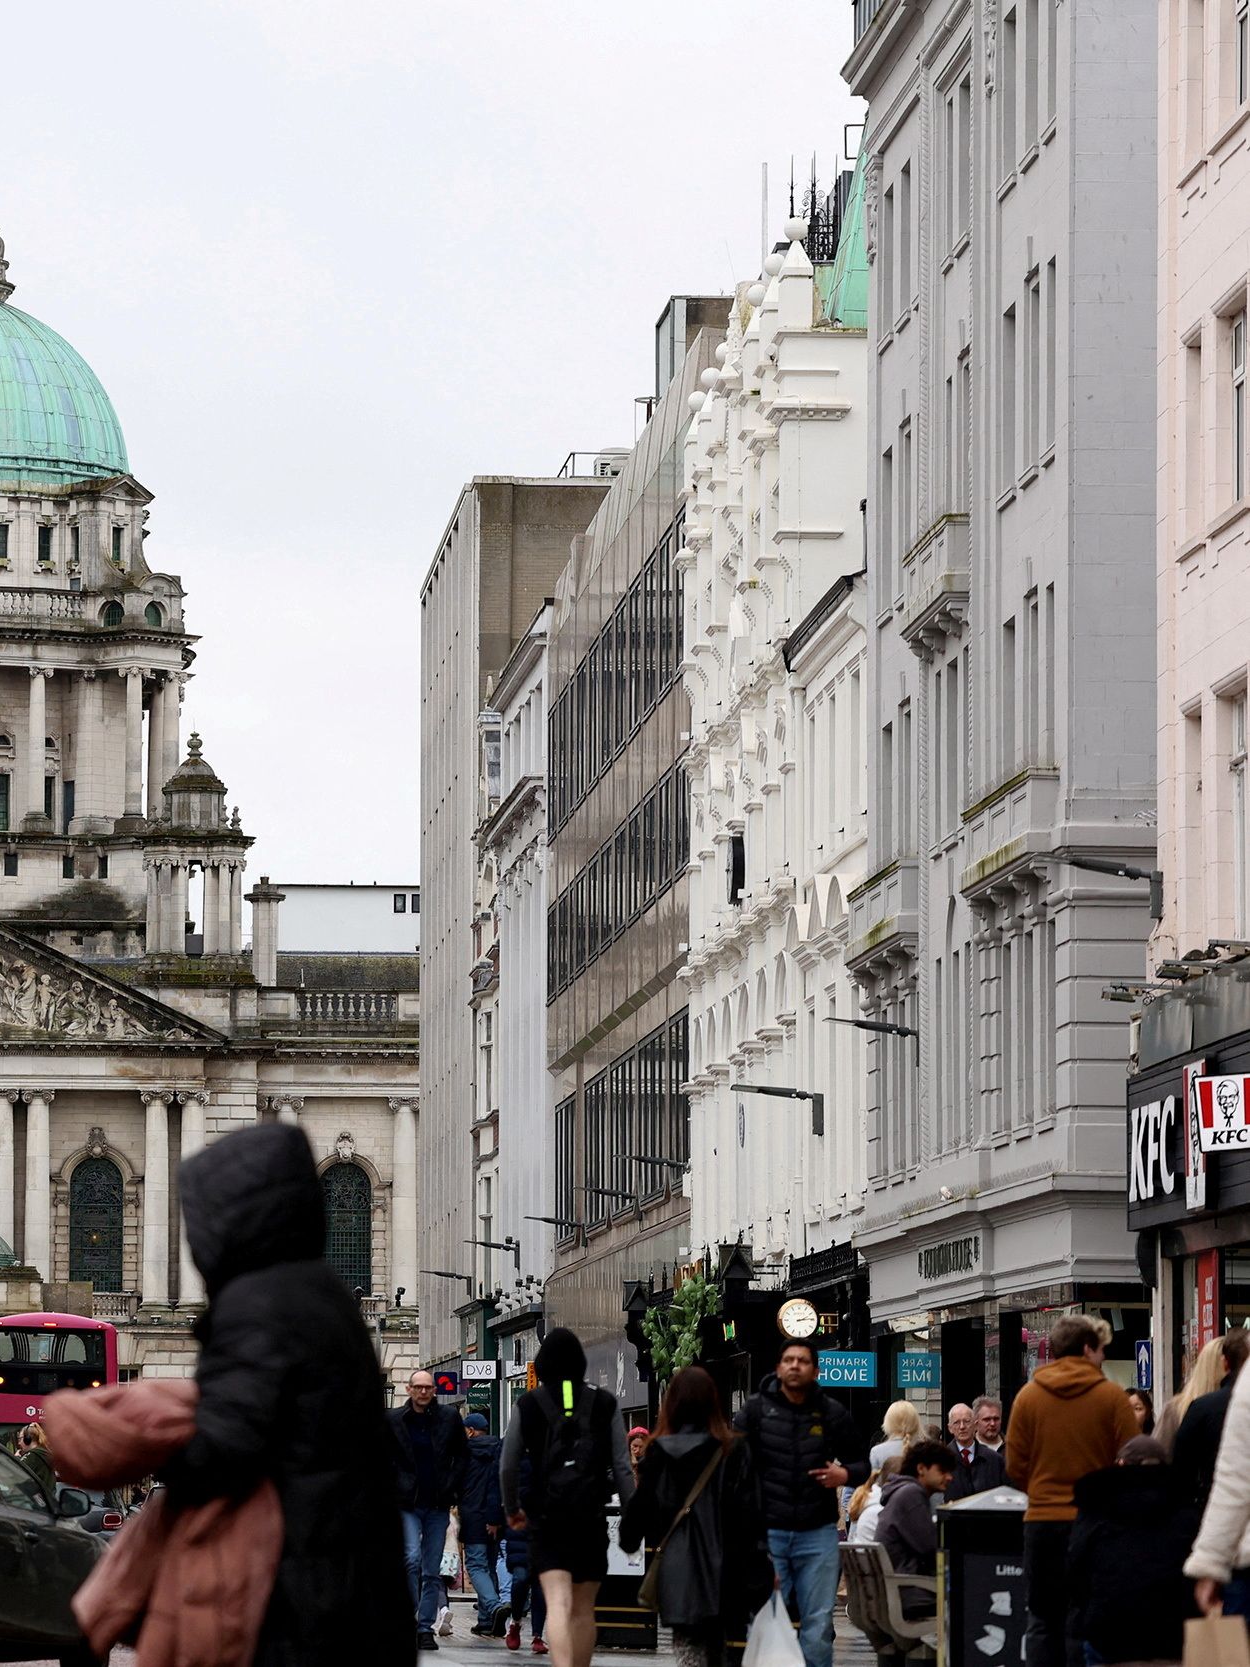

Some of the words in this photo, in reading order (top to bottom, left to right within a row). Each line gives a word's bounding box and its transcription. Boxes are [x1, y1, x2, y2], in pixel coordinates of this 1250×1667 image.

[1211, 1129, 1248, 1145] KFC
[1129, 1095, 1175, 1203] KFC
[818, 1357, 868, 1367] PRIMARK
[466, 1364, 492, 1376] DV8
[817, 1368, 868, 1382] HOME
[995, 1564, 1024, 1577] Litte
